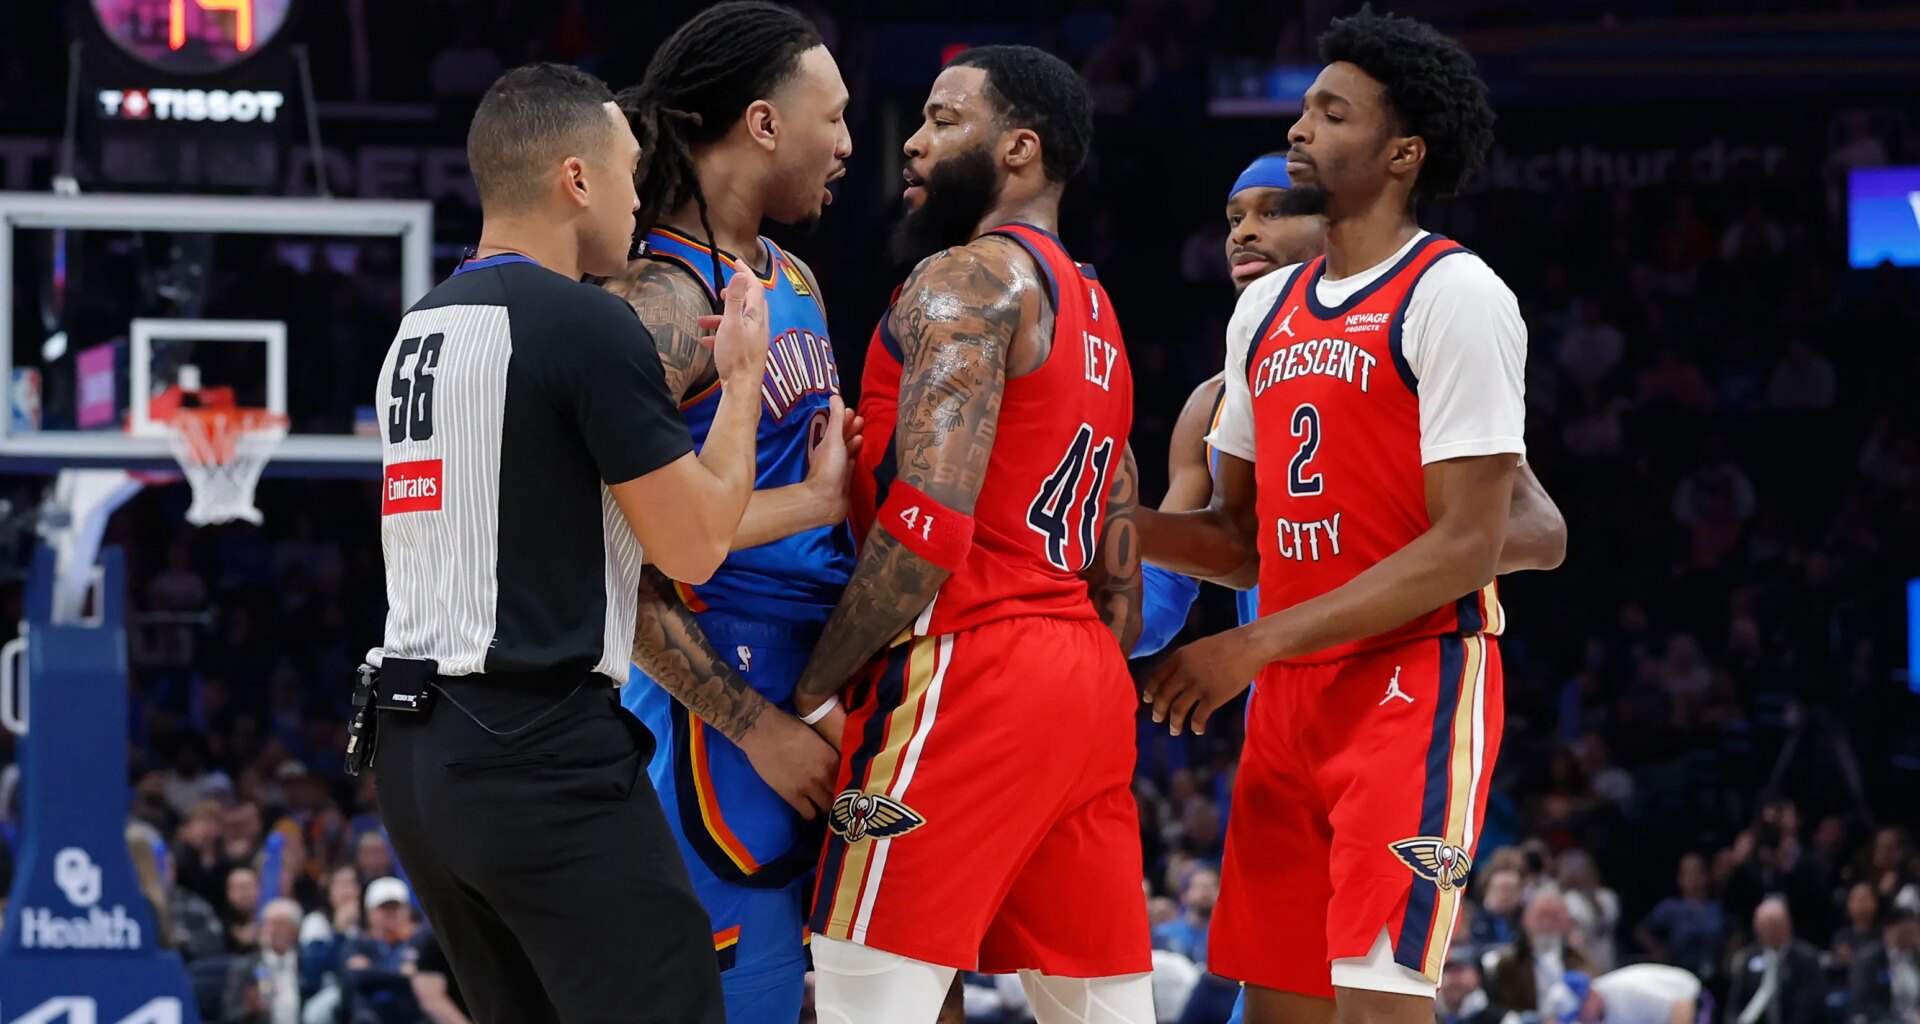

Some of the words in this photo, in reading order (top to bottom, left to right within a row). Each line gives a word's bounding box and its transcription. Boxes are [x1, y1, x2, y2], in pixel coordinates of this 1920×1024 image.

[147, 88, 284, 122] TISSOT
[1344, 324, 1380, 333] PRODUCTS
[1345, 312, 1390, 326] NEWAGE
[761, 329, 840, 424] THUNDE
[1082, 330, 1118, 392] EY
[1254, 337, 1377, 398] CRESCENT
[388, 332, 445, 444] 56
[1287, 402, 1323, 498] 2
[387, 474, 438, 502] Emirates
[1025, 422, 1115, 573] 41
[899, 505, 935, 541] 41
[1276, 512, 1341, 562] CITY
[21, 903, 142, 950] Health
